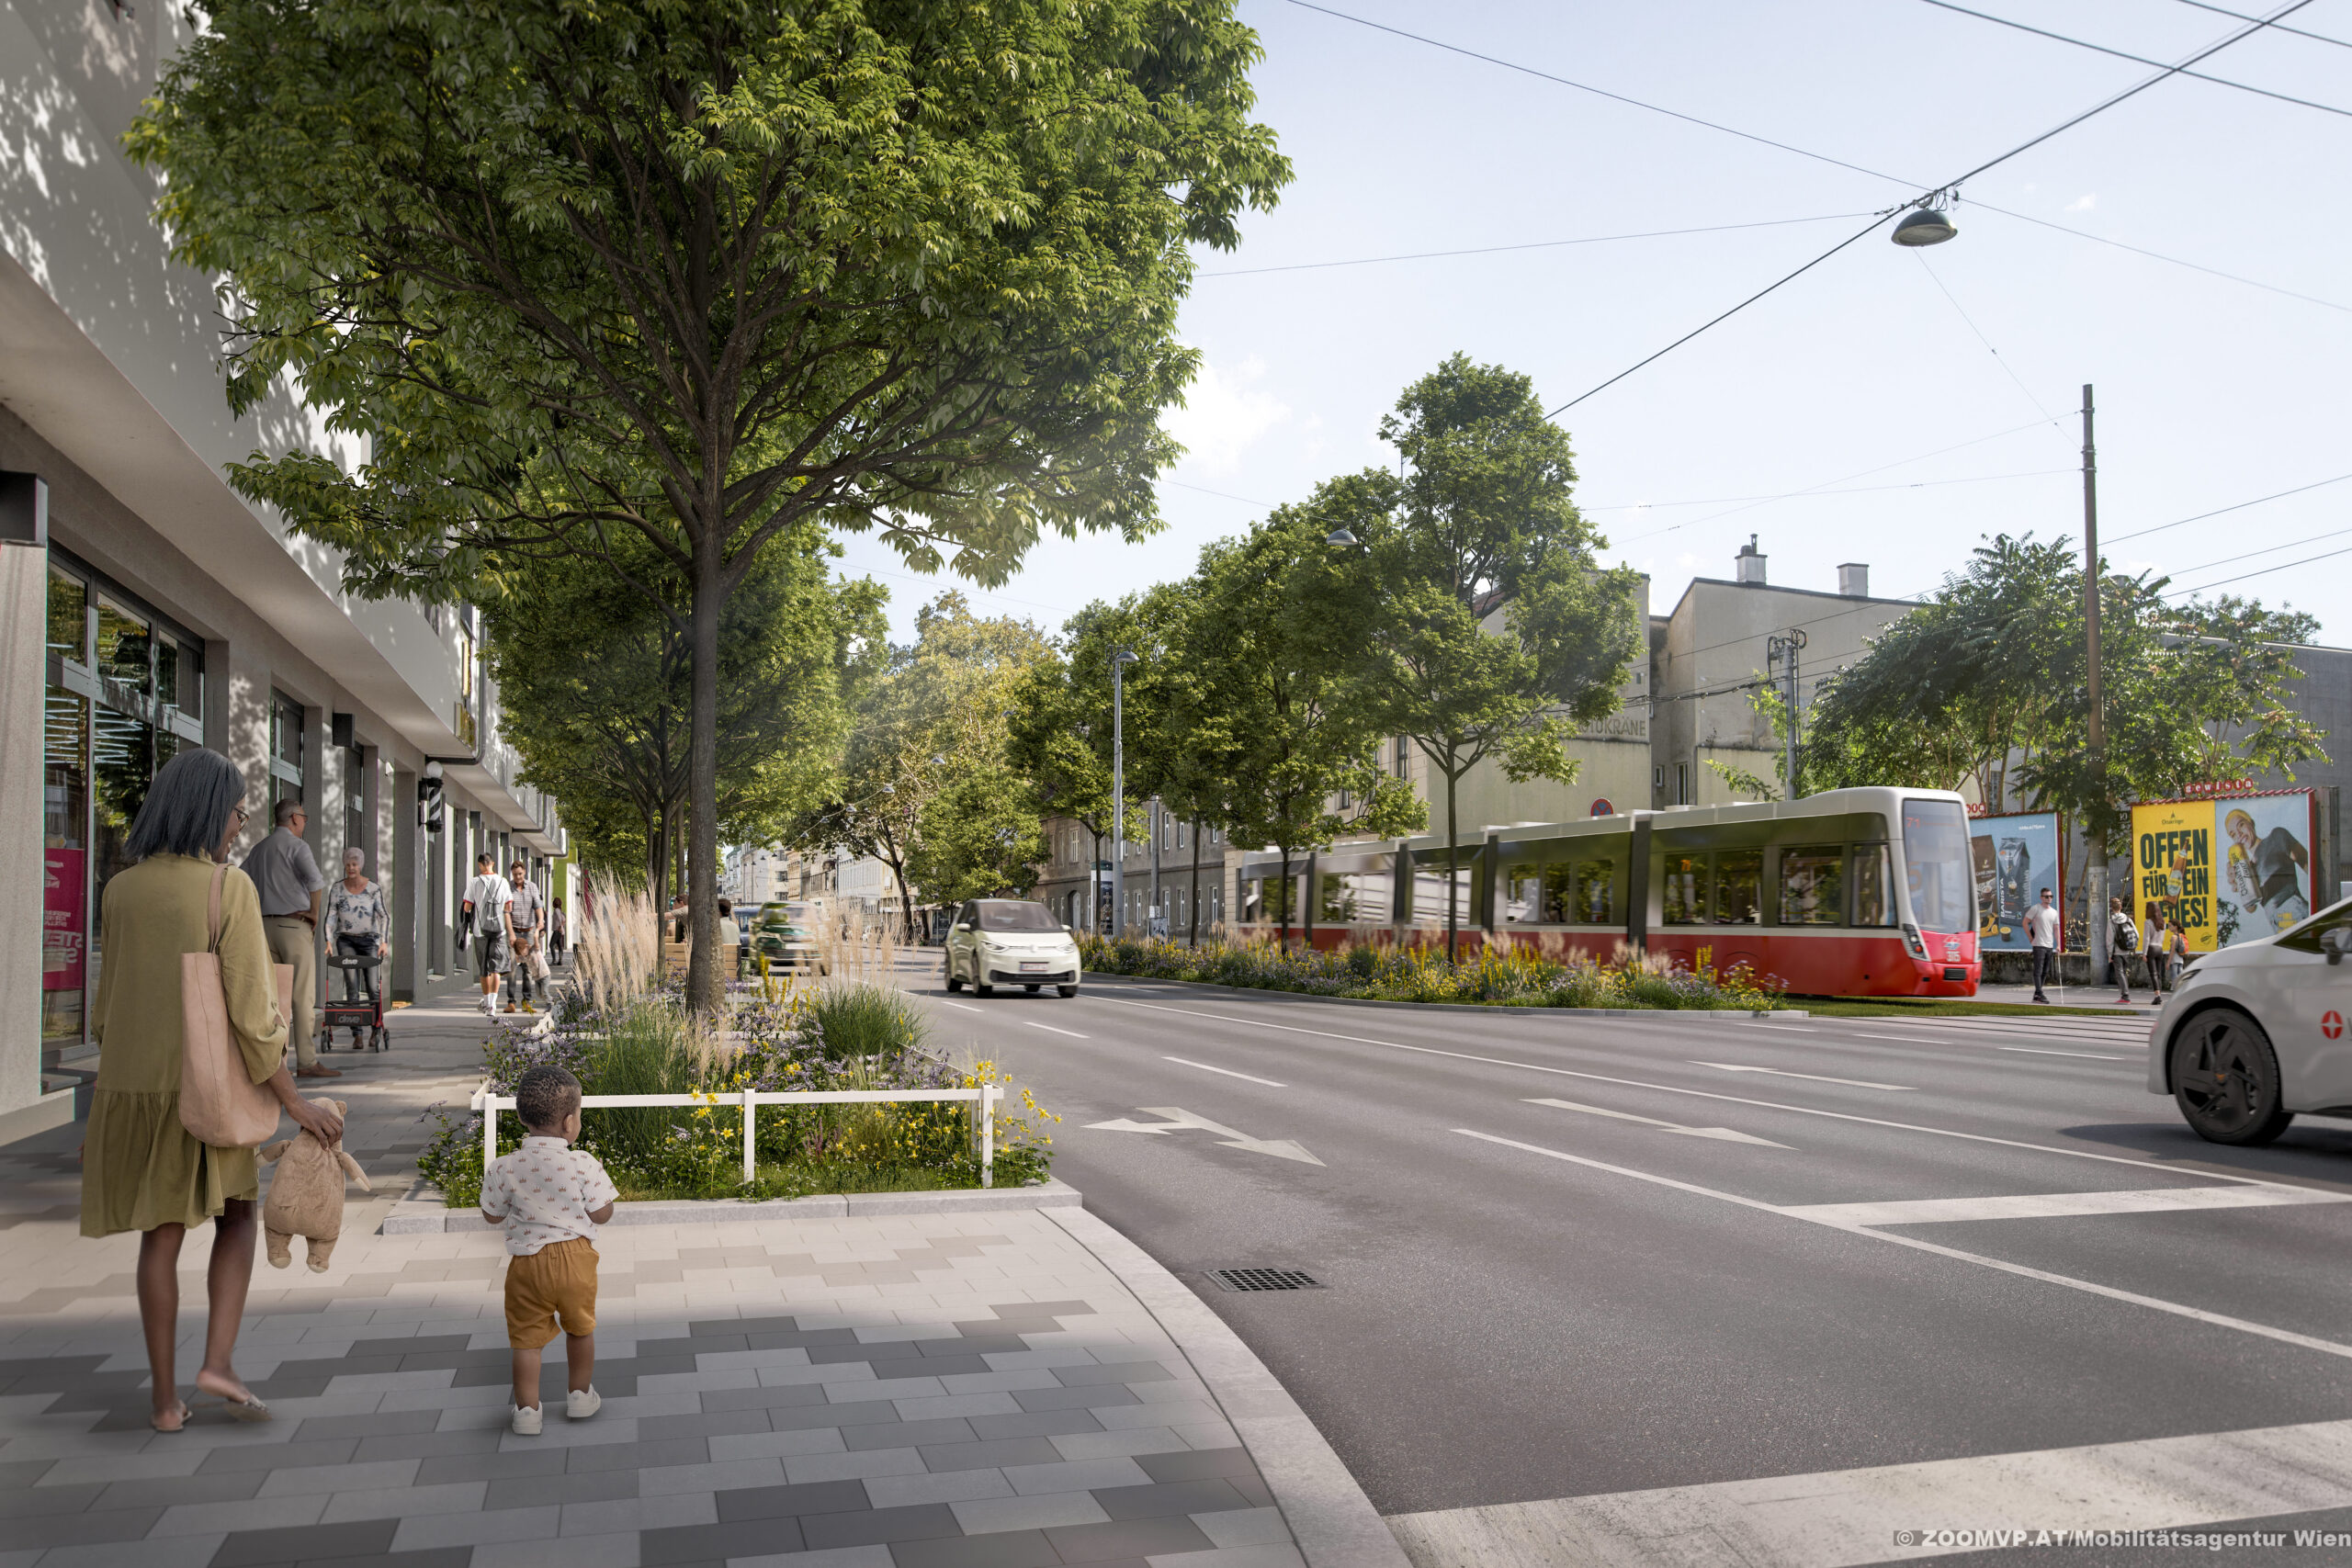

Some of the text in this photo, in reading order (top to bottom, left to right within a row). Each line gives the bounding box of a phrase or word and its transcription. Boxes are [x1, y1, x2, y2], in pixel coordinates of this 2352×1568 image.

[1905, 817, 1920, 829] 71
[2140, 829, 2209, 869] OFFEN
[2143, 869, 2168, 898] FÜR
[2182, 867, 2209, 897] EIN
[2158, 897, 2209, 930] EES!
